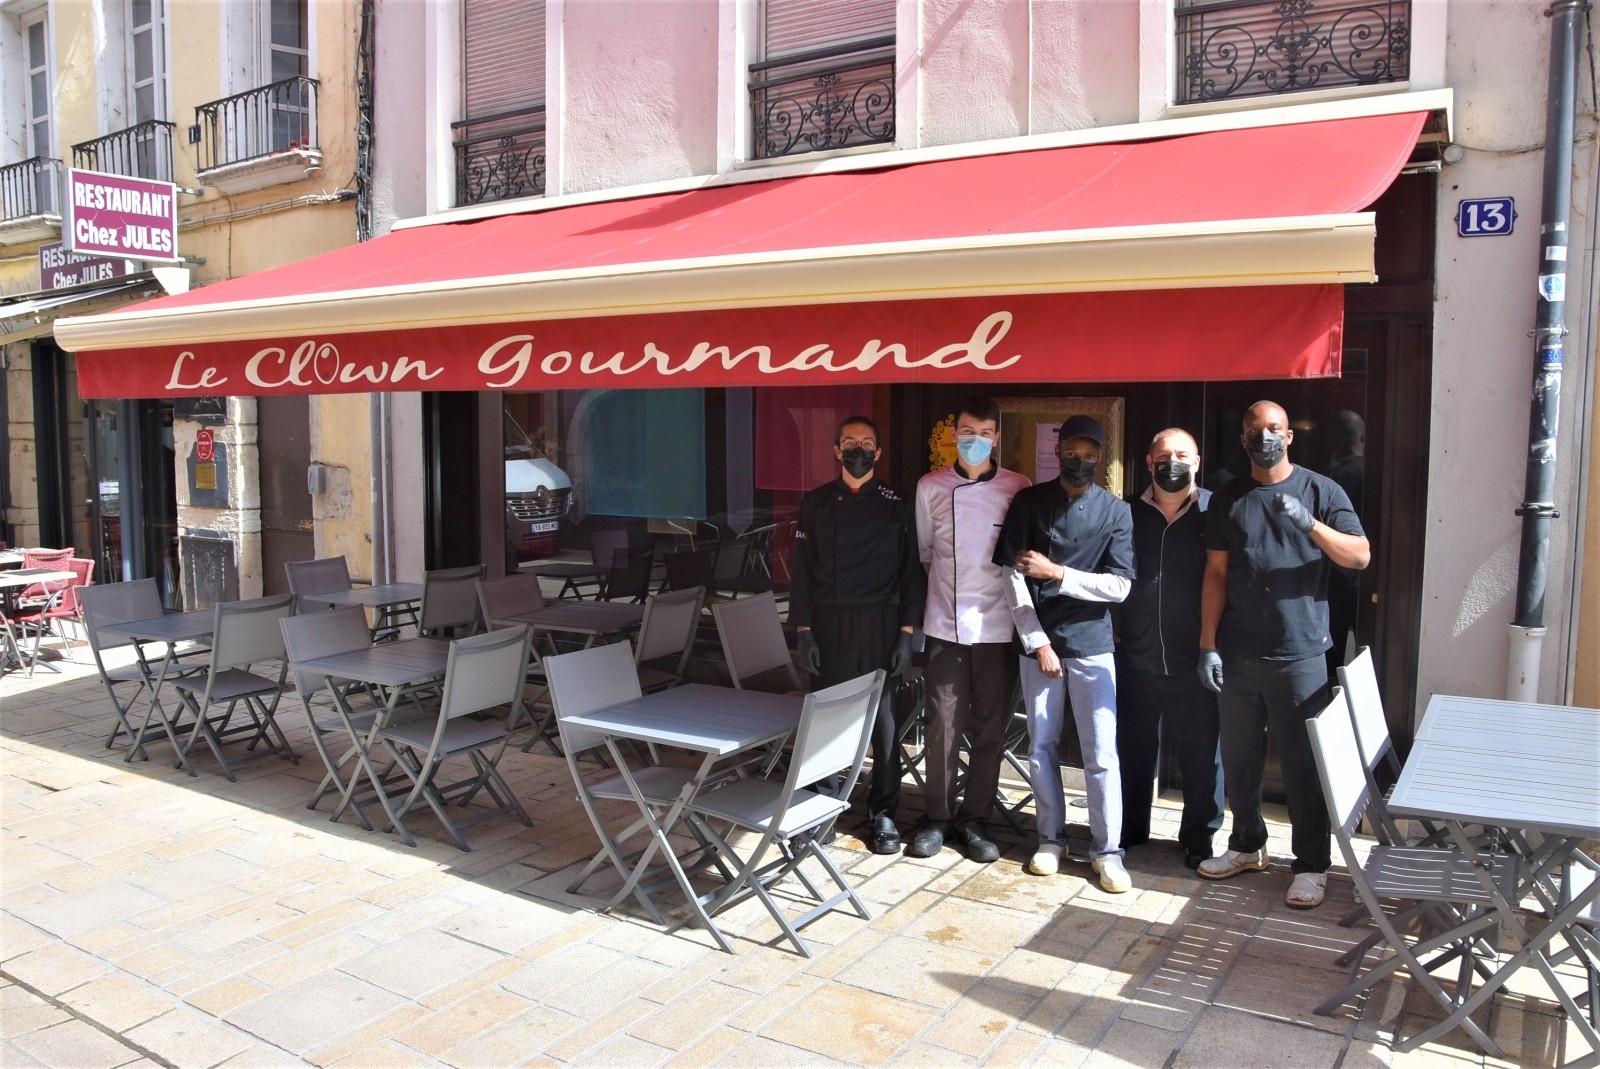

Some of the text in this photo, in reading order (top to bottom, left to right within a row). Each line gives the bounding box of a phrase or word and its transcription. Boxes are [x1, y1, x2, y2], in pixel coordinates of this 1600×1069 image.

[75, 181, 171, 219] RESTAURANT
[1466, 202, 1506, 232] 13
[76, 217, 172, 252] Chez JULES
[53, 271, 78, 289] Chez
[165, 350, 228, 390] Le
[477, 311, 1021, 388] Gourmand
